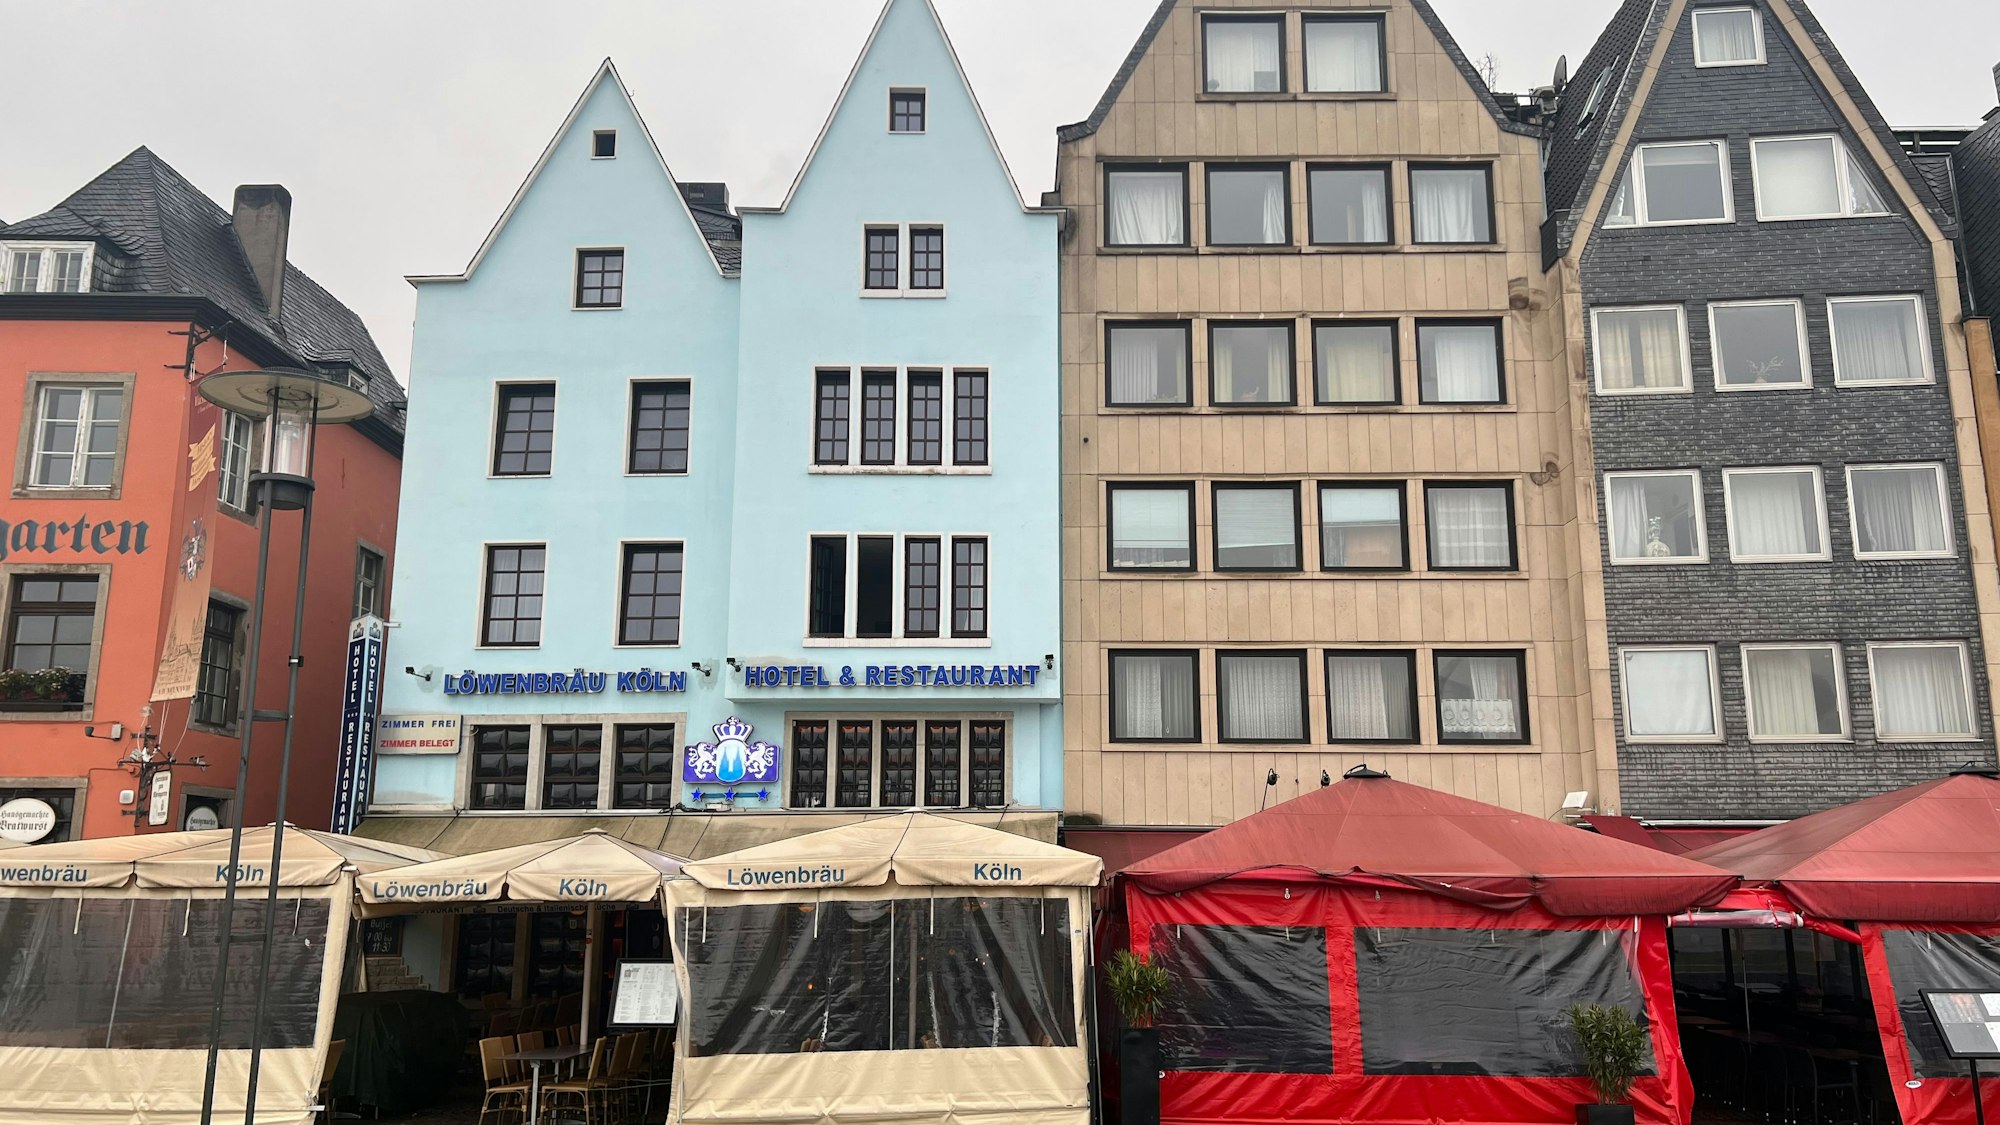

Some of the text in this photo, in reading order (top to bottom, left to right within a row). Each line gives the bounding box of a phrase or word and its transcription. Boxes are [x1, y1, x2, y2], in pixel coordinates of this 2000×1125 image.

[367, 644, 377, 703] HOTEL
[443, 667, 686, 695] LÖWENBRÄU KÖLN
[744, 664, 1041, 687] HOTEL & RESTAURANT
[381, 719, 456, 729] ZIMMER FREI
[338, 644, 361, 834] HOTEL RESTAURANT
[380, 739, 455, 748] ZIMMER BELEGT
[0, 820, 48, 831] Bratwurst
[215, 864, 264, 882] Köln
[727, 865, 845, 886] Löwenbräu
[973, 863, 1022, 881] Köln
[373, 878, 488, 899] Löwenbräu
[558, 878, 608, 897] Köln
[497, 905, 534, 913] Deutsche
